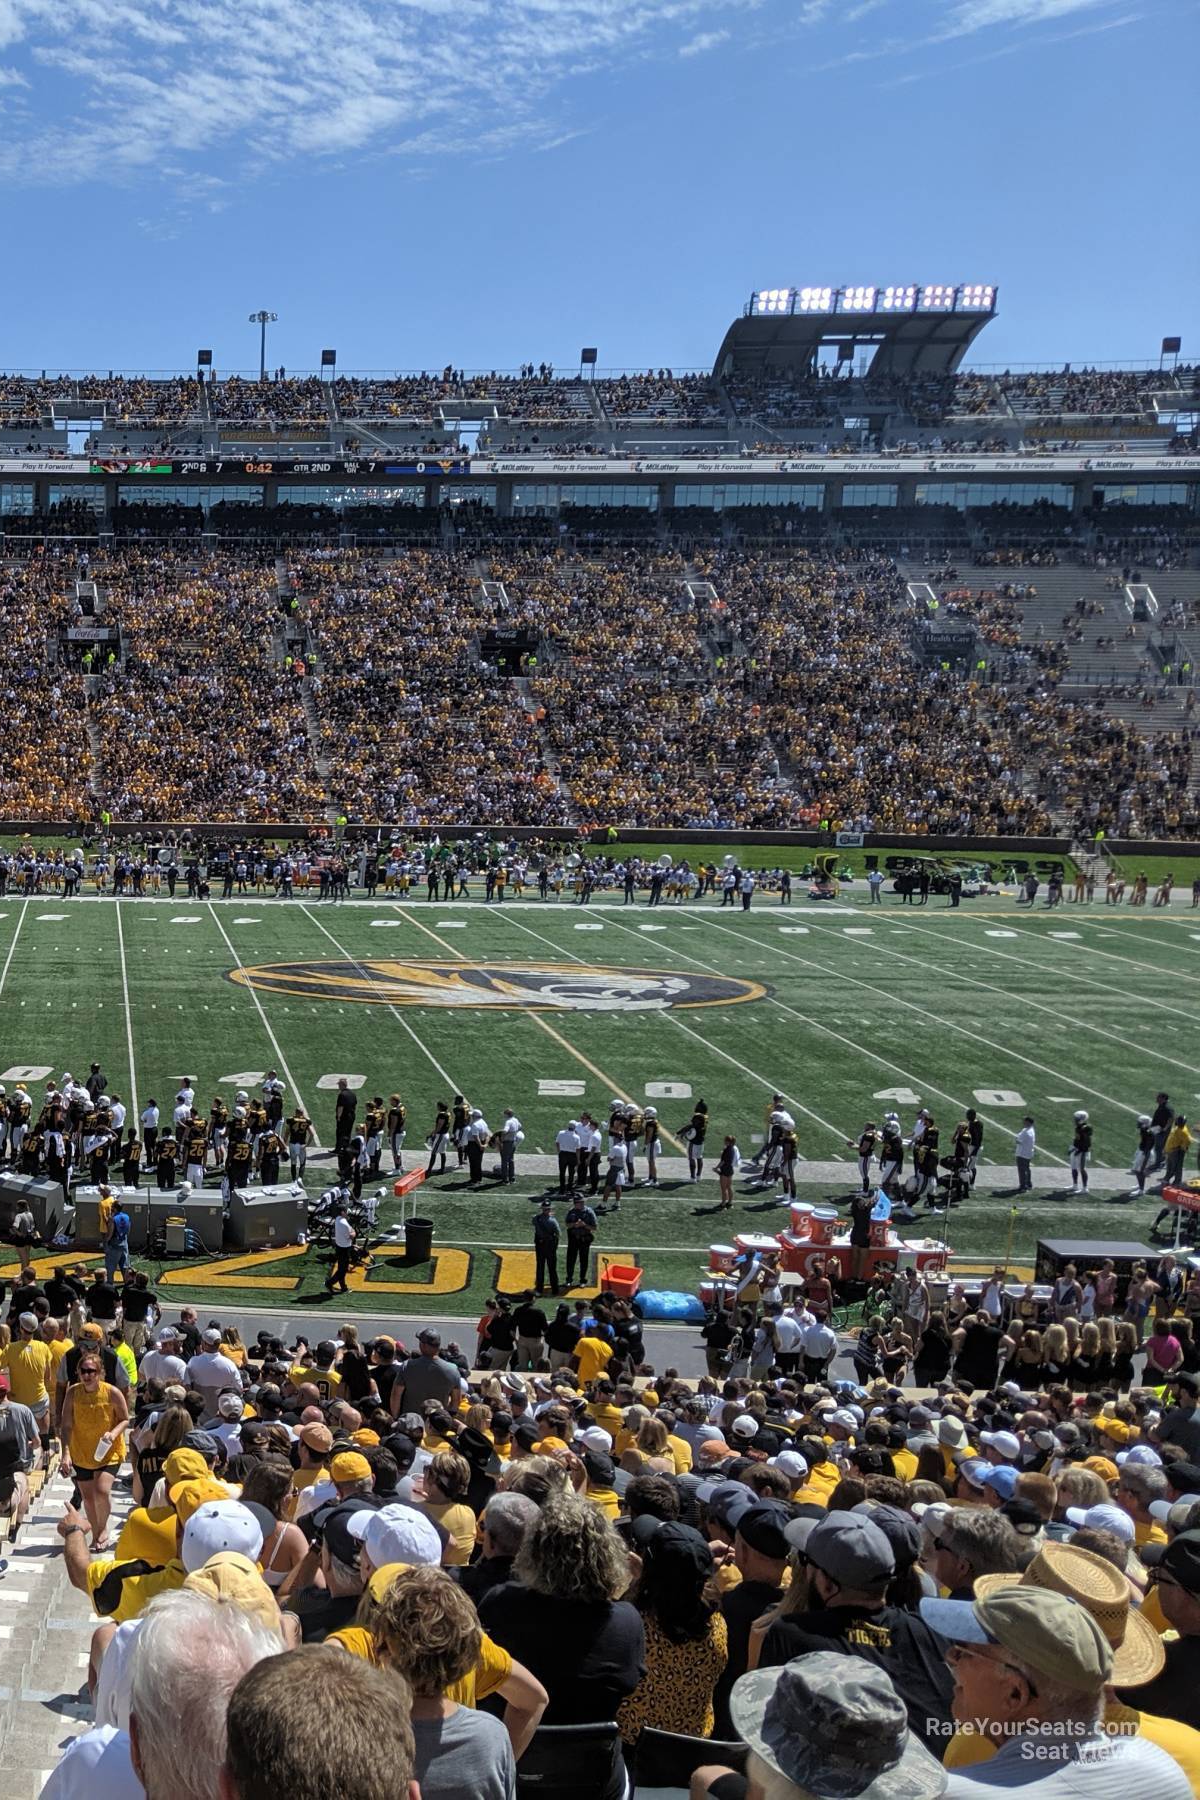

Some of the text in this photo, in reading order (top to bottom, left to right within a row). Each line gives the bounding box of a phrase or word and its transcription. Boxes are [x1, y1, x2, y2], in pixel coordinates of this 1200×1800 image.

[135, 462, 152, 473] 24
[181, 463, 198, 473] 2ND
[216, 463, 223, 473] 7
[245, 463, 273, 473] 0:42
[311, 463, 331, 472] 2ND
[369, 462, 376, 472] 7
[417, 463, 426, 473] 0
[926, 633, 952, 643] Health
[129, 1147, 141, 1161] 10
[160, 1147, 177, 1159] 24
[189, 1144, 205, 1157] 26
[233, 1148, 250, 1161] 29
